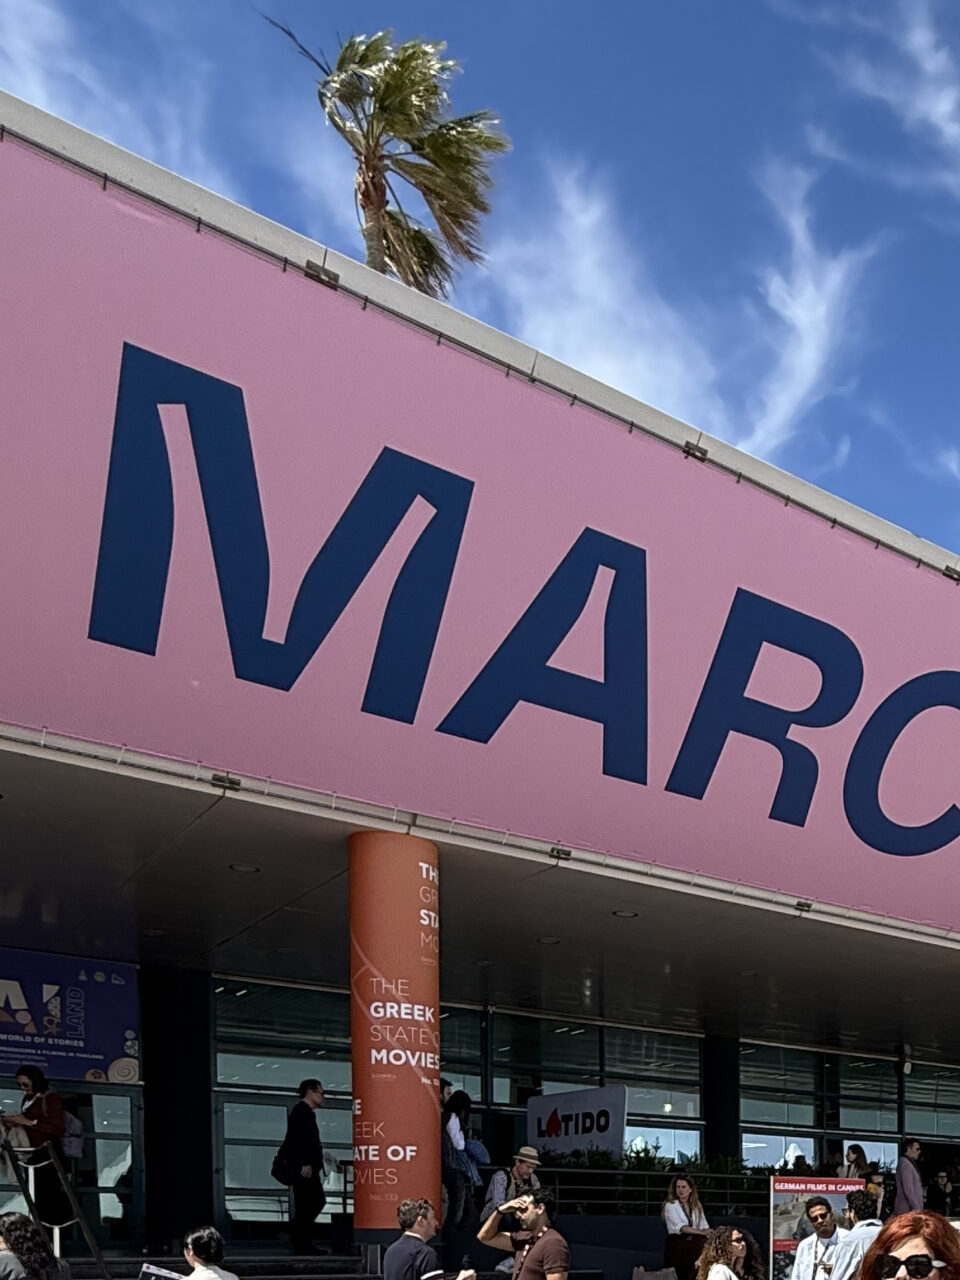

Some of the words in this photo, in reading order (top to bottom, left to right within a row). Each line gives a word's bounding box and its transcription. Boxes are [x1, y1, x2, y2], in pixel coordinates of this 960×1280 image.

[370, 978, 410, 996] THE
[370, 1002, 434, 1023] GREEK
[48, 1037, 84, 1047] STORIES
[370, 1024, 429, 1046] STATE
[371, 1049, 440, 1070] MOVIES
[387, 1145, 418, 1161] OF
[774, 1183, 805, 1191] GERMAN
